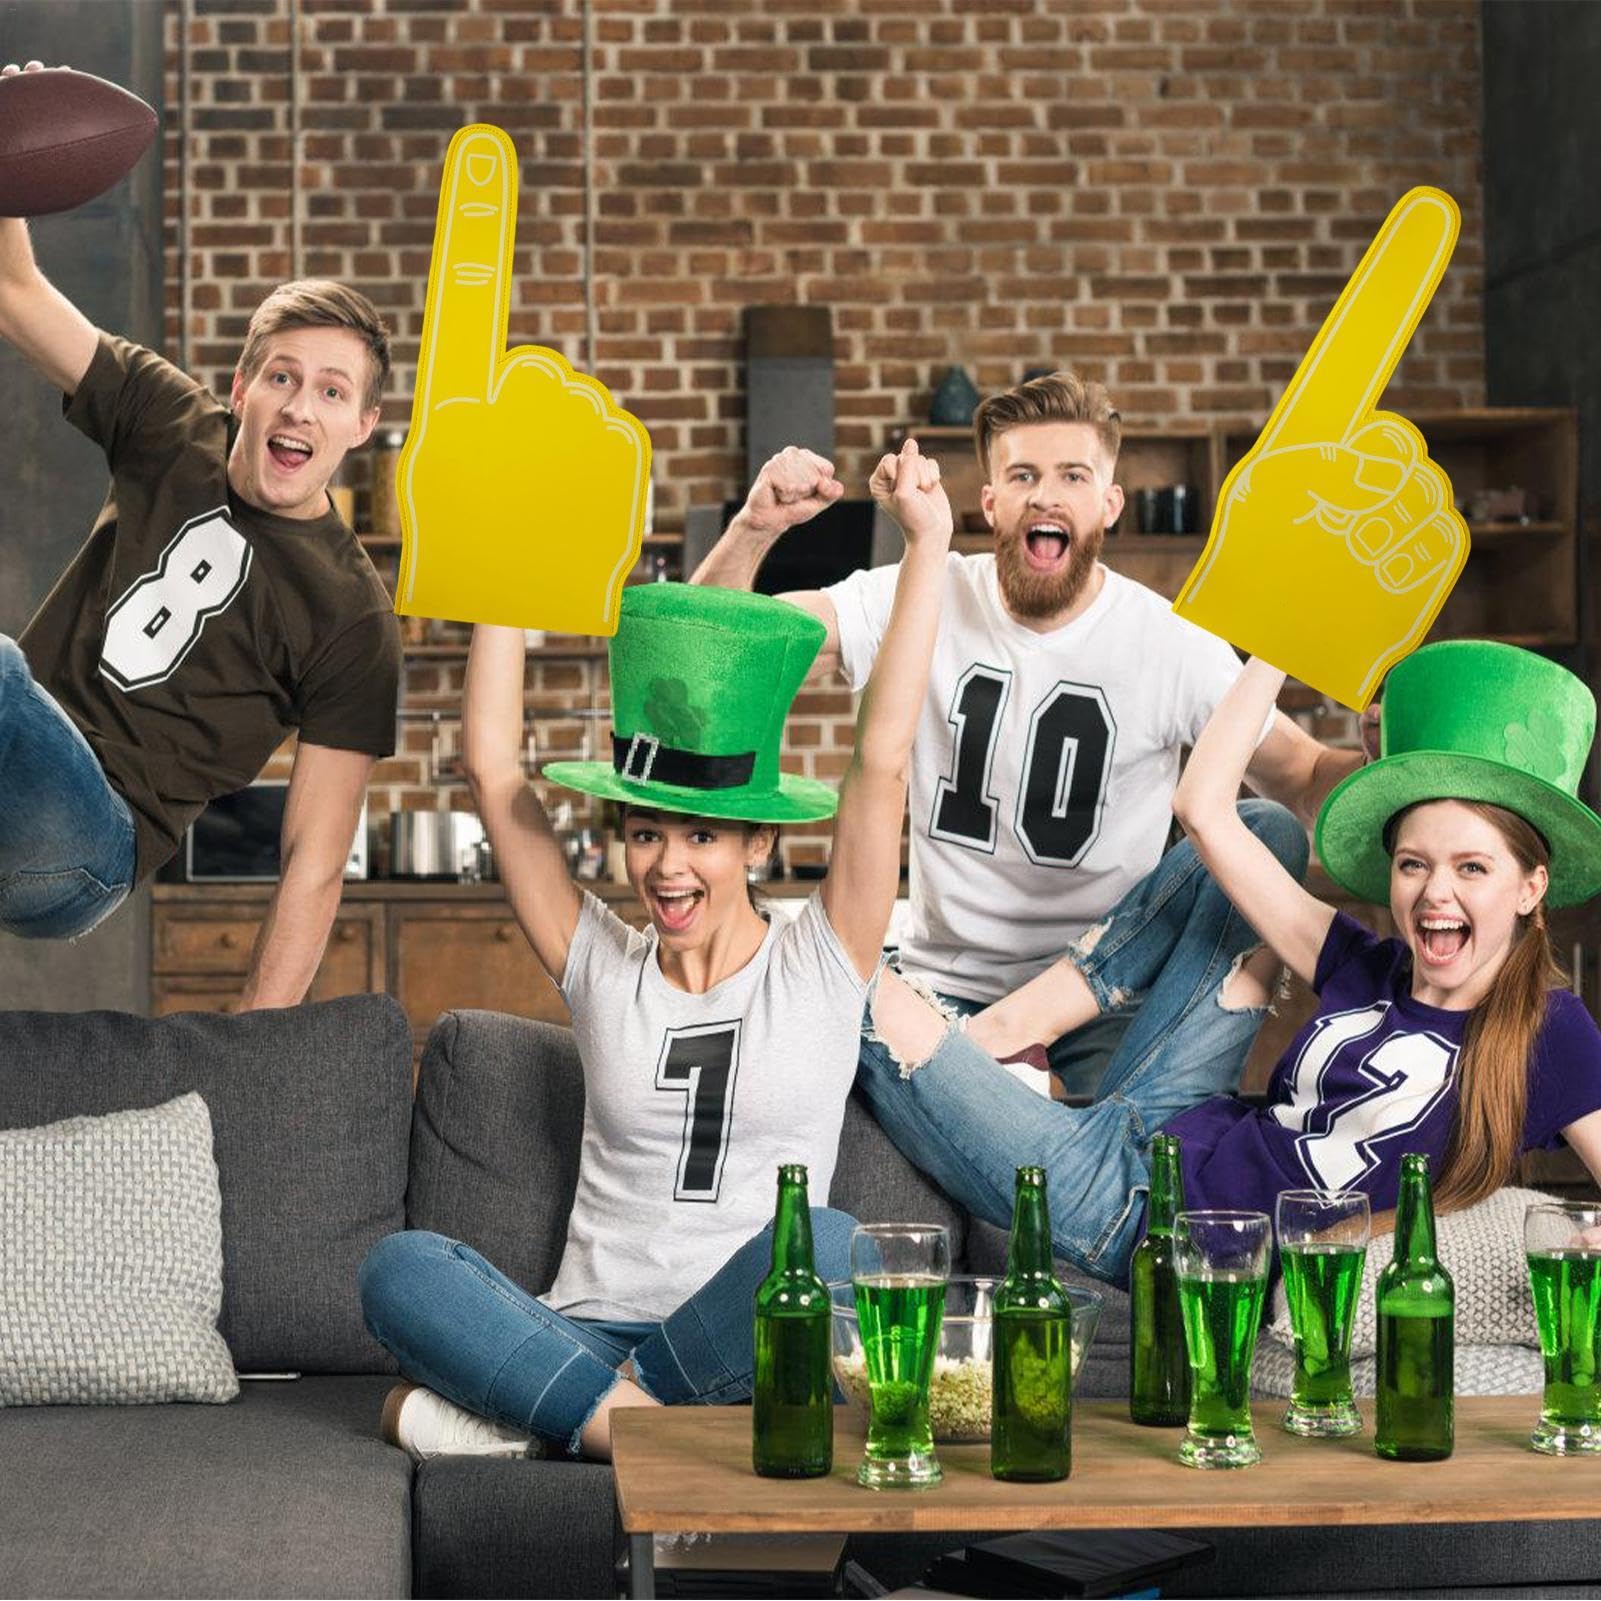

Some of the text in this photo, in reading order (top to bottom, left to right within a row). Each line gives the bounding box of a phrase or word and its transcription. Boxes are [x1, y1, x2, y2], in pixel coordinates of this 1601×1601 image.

[98, 505, 253, 692] 8
[928, 662, 1117, 869] 10
[1268, 1000, 1461, 1209] 12
